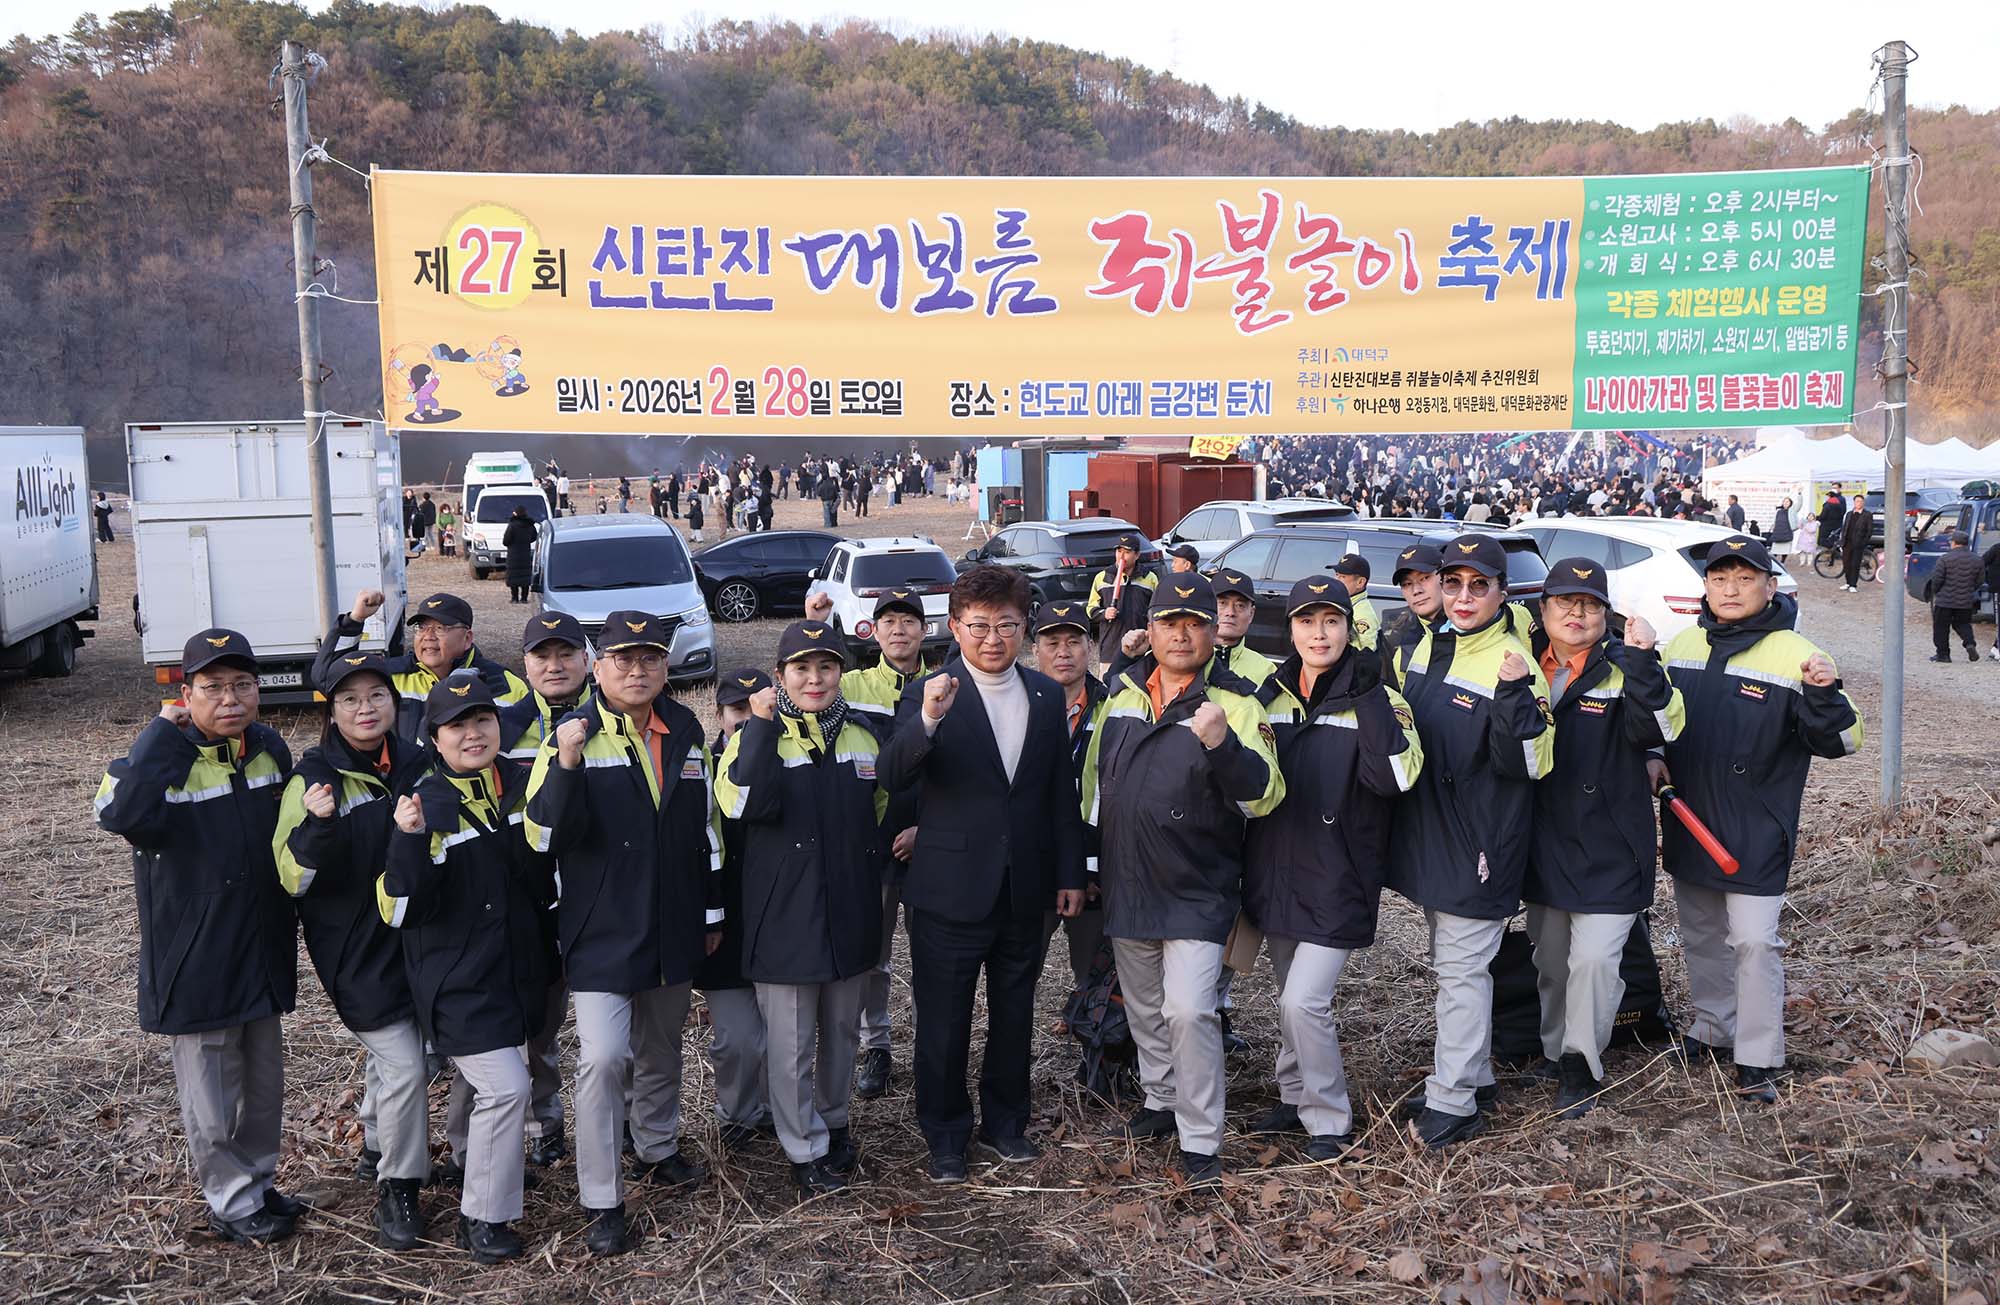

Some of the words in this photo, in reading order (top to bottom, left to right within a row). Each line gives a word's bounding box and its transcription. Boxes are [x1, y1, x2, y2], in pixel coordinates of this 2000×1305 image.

[1604, 192, 1680, 218] 각종체험
[1703, 190, 1743, 214] 오후
[1598, 222, 1676, 247] 소원고사
[1700, 220, 1740, 244] 오후
[1751, 219, 1782, 242] 5시
[1792, 217, 1837, 241] 00분
[413, 226, 568, 298] 제27회
[588, 226, 774, 311] 신탄진
[784, 209, 1058, 315] 대보름
[1086, 191, 1419, 333] 쥐불놀이
[1437, 215, 1571, 301] 축제
[1698, 250, 1739, 273] 오후
[1749, 249, 1781, 272] 6시
[1790, 246, 1836, 270] 30분
[1606, 289, 1659, 319] 각종
[1665, 286, 1769, 318] 체험행사
[1776, 285, 1827, 315] 운영
[1586, 329, 1650, 357] 투호던지기,
[1656, 327, 1707, 356] 제기차기,
[1836, 324, 1849, 351] 등
[1297, 348, 1321, 365] 주최
[1351, 347, 1389, 362] 대덕구
[557, 377, 599, 413] 일시
[620, 377, 701, 414] 2026년
[708, 366, 755, 416] 2월
[763, 366, 831, 416] 28일
[840, 380, 903, 415] 토요일
[1296, 372, 1321, 388] 주관
[1330, 371, 1402, 388] 신탄진대보름
[1406, 370, 1477, 387] 쥐불놀이축제
[1480, 369, 1540, 387] 추진위원회
[1584, 374, 1689, 413] 나이아가라
[1696, 374, 1716, 412] 및
[1721, 371, 1799, 411] 불꽃놀이
[1805, 371, 1845, 408] 축제
[950, 382, 996, 417] 장소
[1020, 381, 1089, 417] 현도교
[1097, 381, 1142, 417] 아래
[1149, 381, 1219, 417] 금강변
[1225, 380, 1272, 416] 둔치
[1296, 396, 1320, 413] 후원
[1353, 397, 1401, 414] 하나은행
[272, 675, 297, 685] 0434
